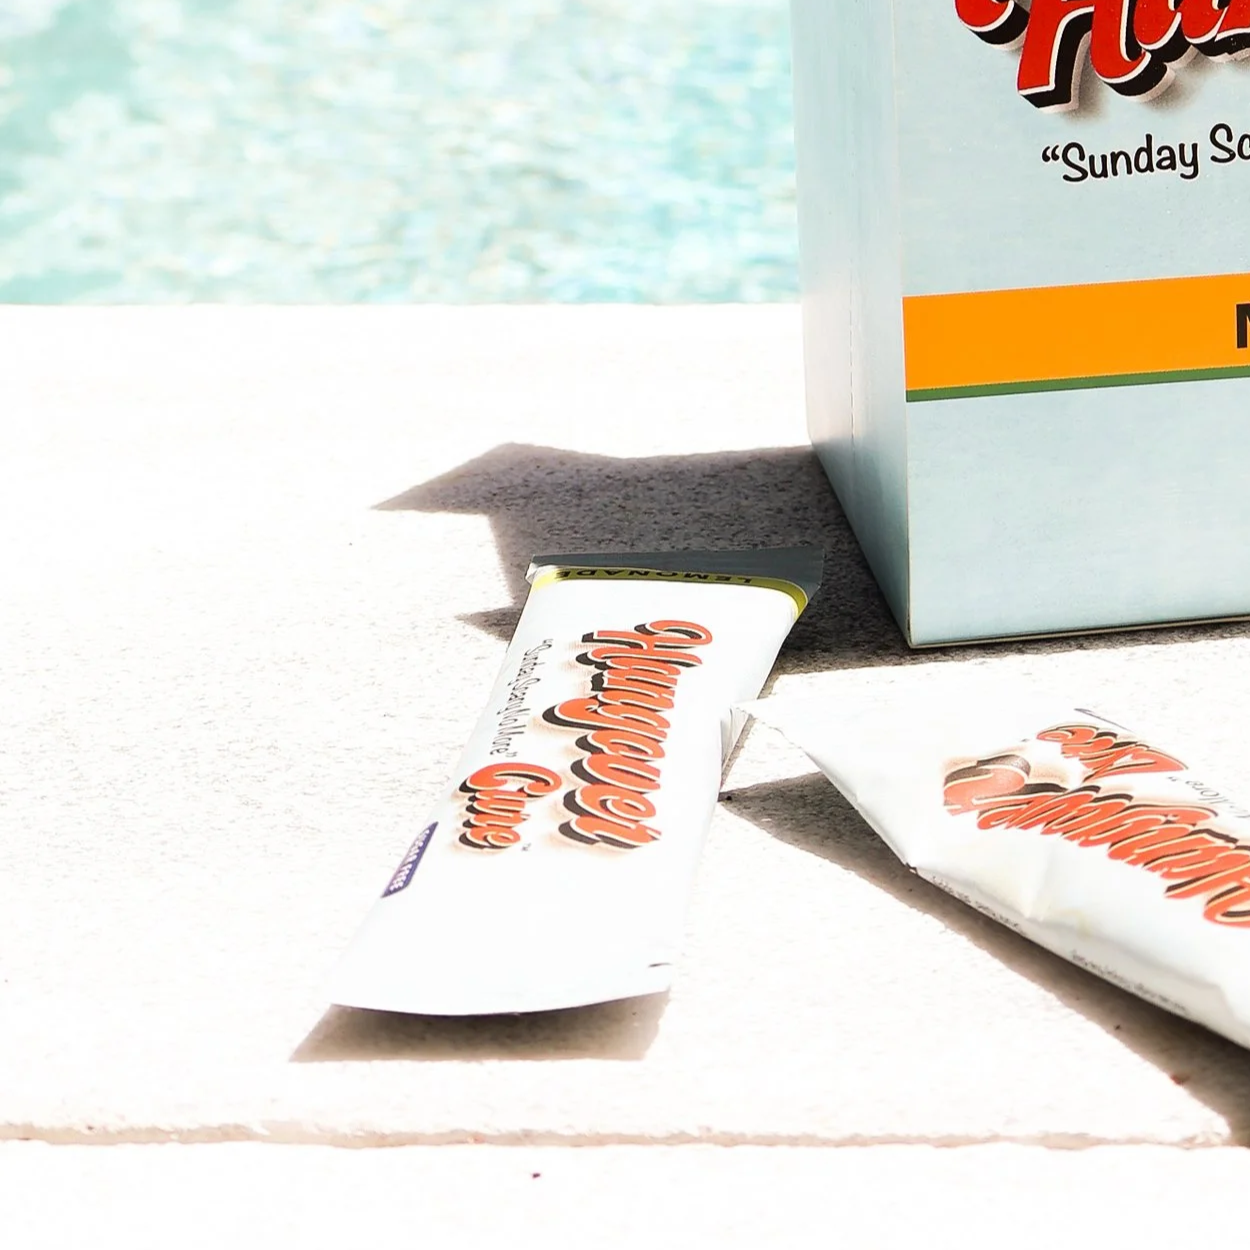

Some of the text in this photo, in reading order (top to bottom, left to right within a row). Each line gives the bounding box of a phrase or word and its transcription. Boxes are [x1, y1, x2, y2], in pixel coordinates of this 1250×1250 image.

[556, 569, 754, 584] LEMONADE
[543, 619, 713, 849] Hangover
[458, 762, 562, 850] Cure
